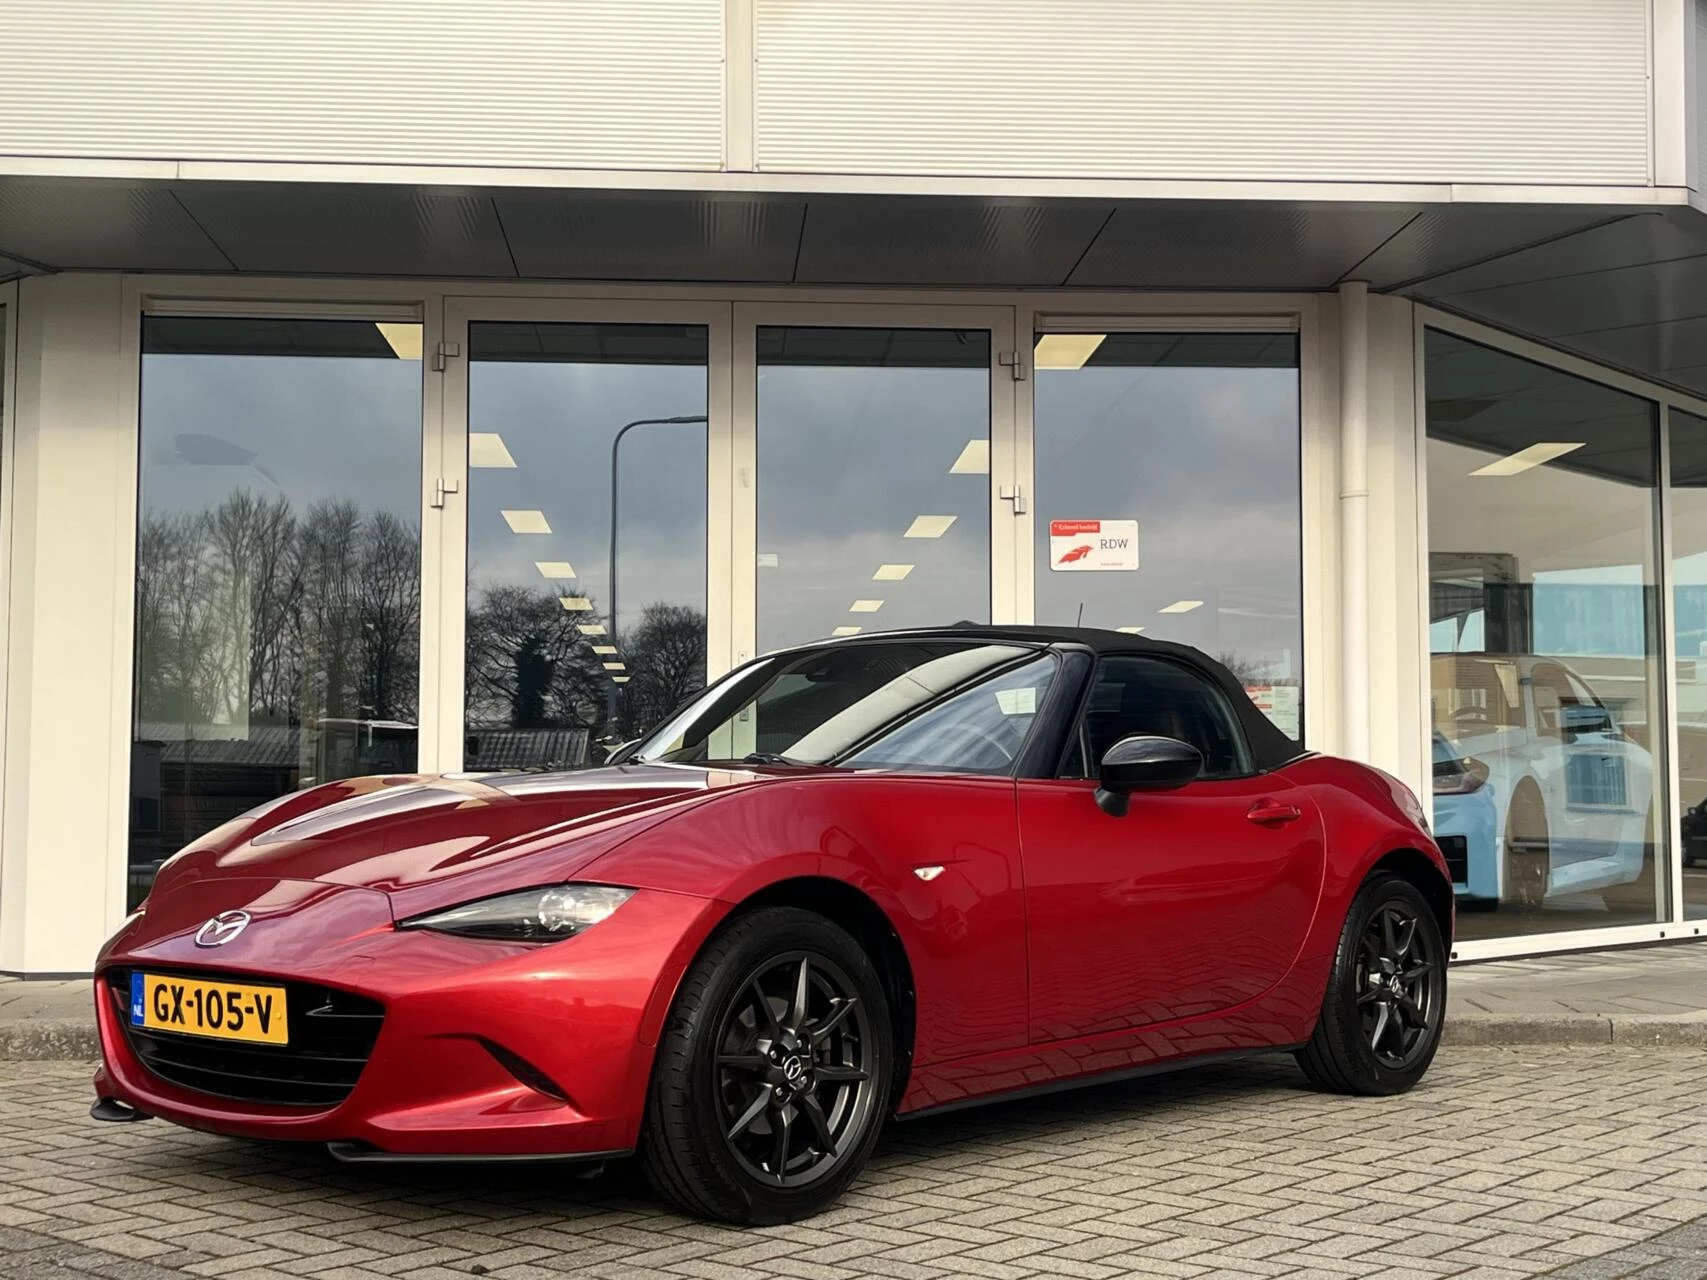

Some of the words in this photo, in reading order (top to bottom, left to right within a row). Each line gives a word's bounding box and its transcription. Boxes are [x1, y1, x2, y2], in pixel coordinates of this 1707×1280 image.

[1100, 539, 1128, 549] RDW
[133, 1004, 143, 1017] NL
[153, 983, 272, 1034] GX-105-V
